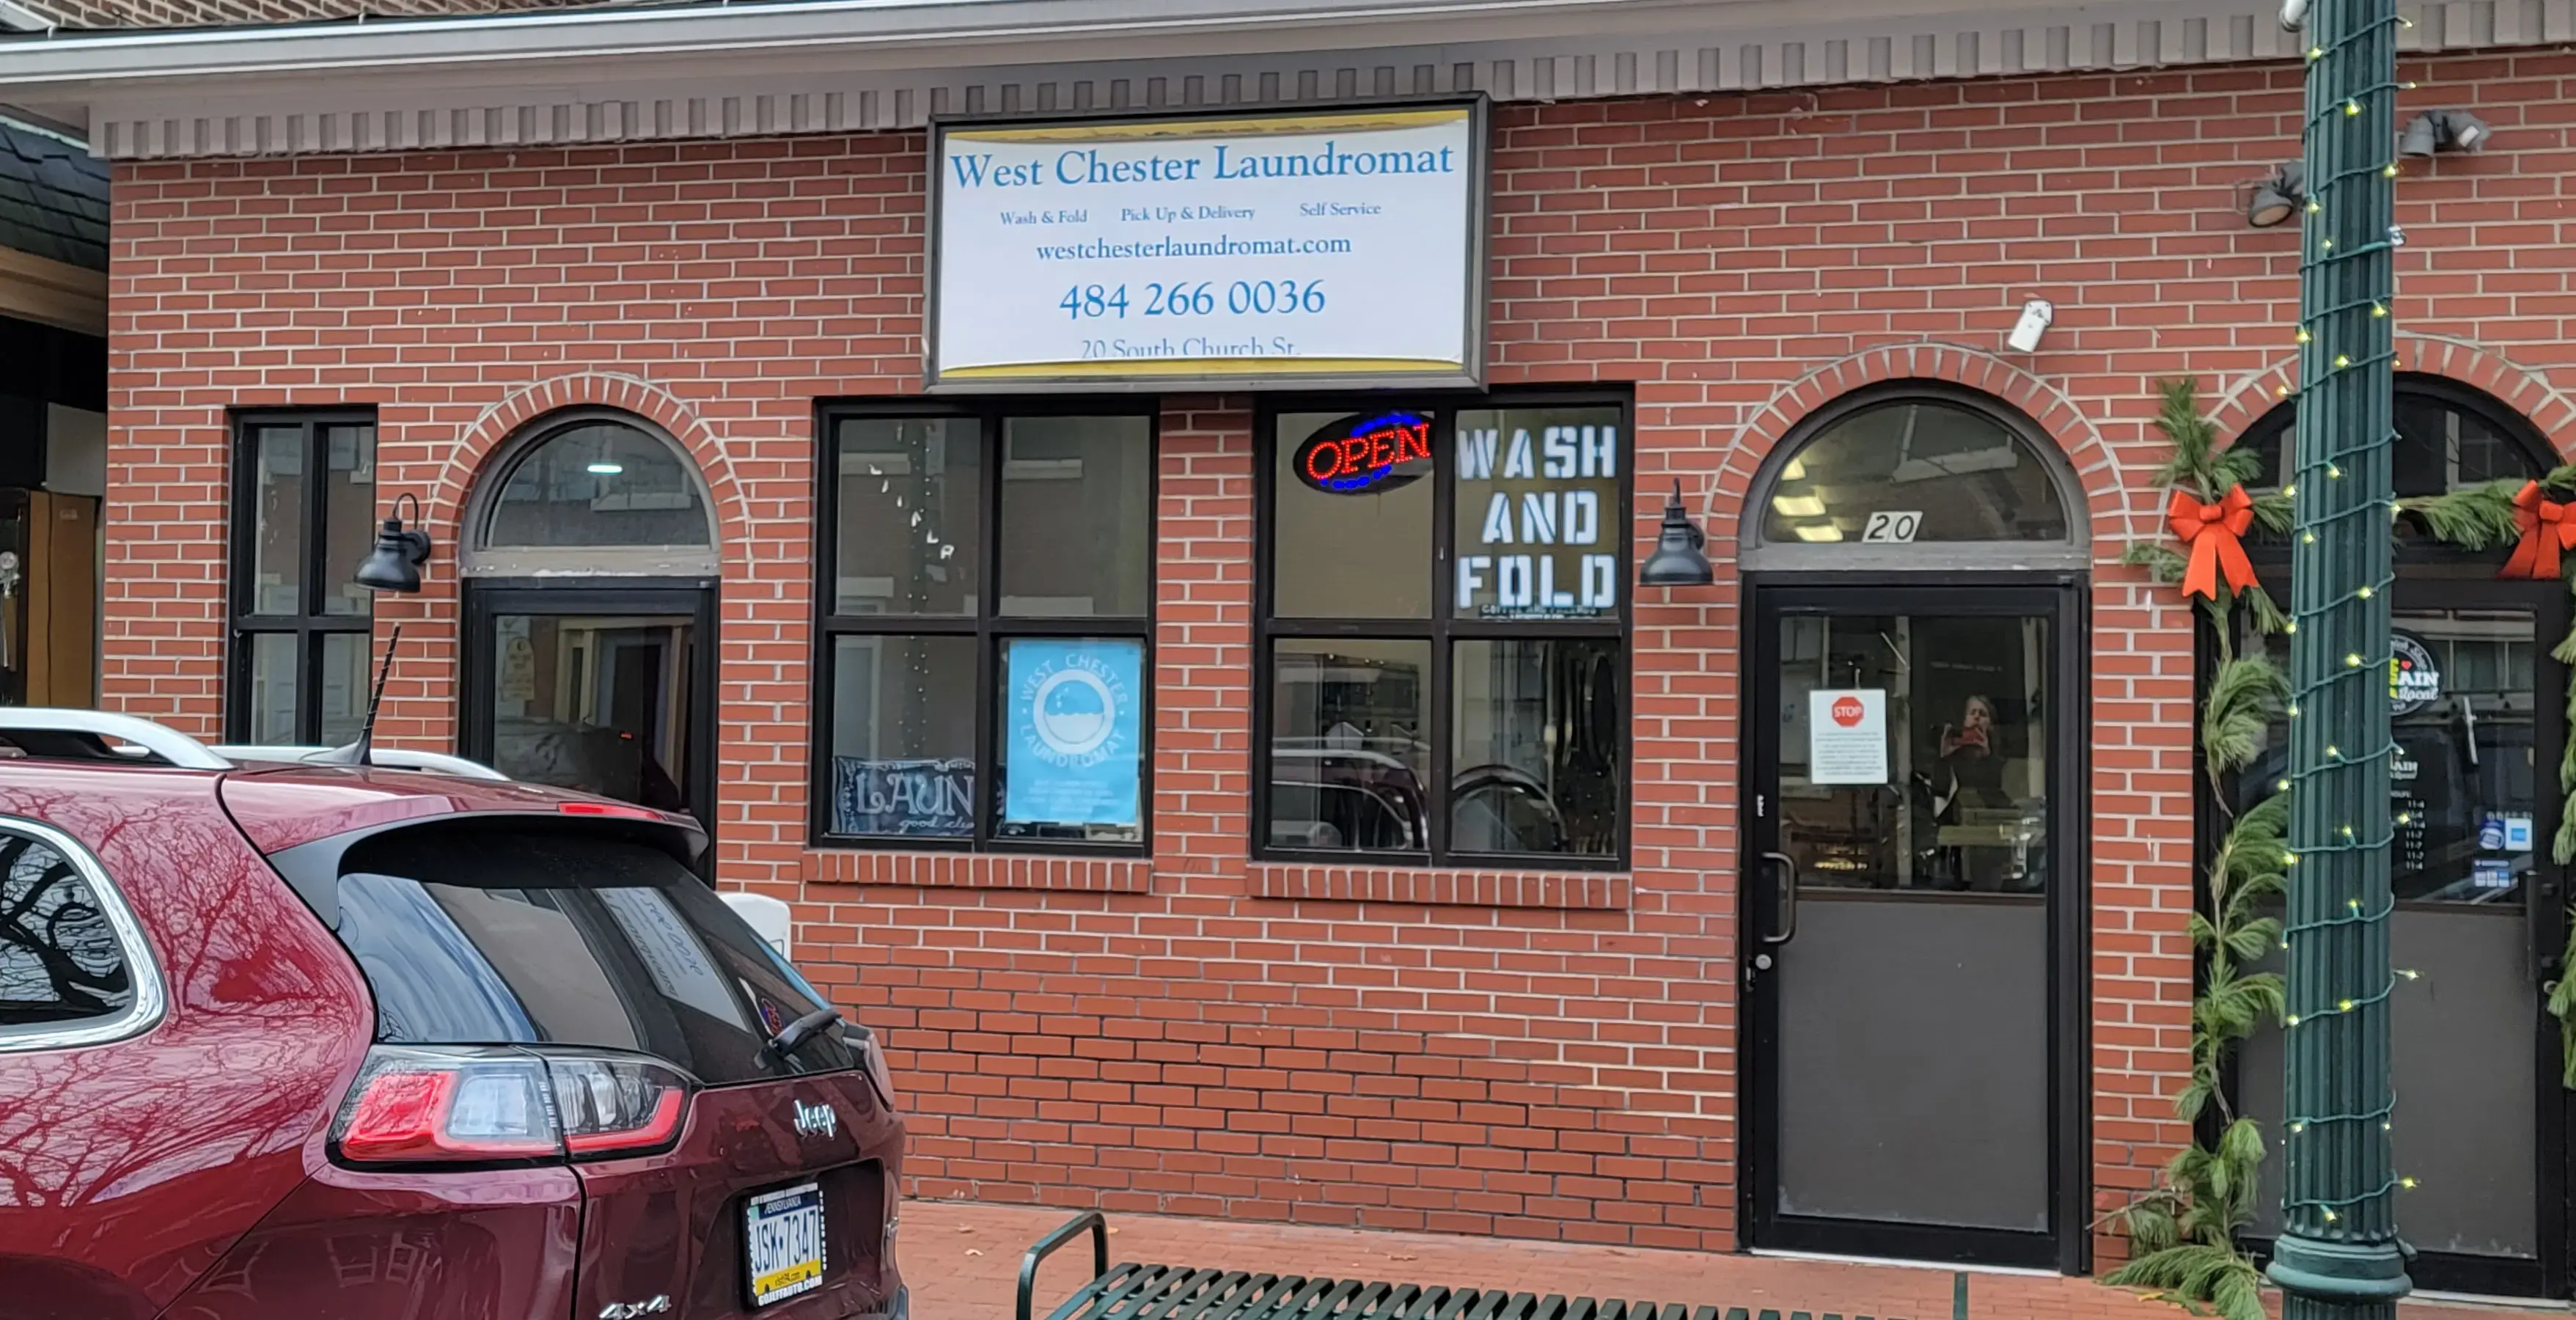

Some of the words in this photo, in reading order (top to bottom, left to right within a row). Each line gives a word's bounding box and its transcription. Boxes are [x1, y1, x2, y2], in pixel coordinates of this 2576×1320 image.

[950, 154, 1042, 188] West
[1054, 150, 1201, 187] Chester
[1213, 140, 1455, 180] Laundromat
[999, 212, 1038, 226] Wash
[1041, 212, 1054, 225] &
[1058, 210, 1088, 224] Fold
[1120, 208, 1153, 222] Pick
[1156, 208, 1178, 222] Up
[1181, 206, 1195, 221] &
[1198, 205, 1255, 222] Delivery
[1299, 202, 1326, 217] Self
[1329, 202, 1382, 217] Service
[1036, 233, 1352, 261] westchesterlaundromat.com
[1058, 284, 1131, 321] 484
[1144, 281, 1215, 317] 266
[1227, 279, 1327, 316] 0036
[1081, 339, 1107, 359] 20
[1112, 338, 1175, 357] South
[1182, 337, 1264, 356] Church
[1306, 422, 1432, 480] OPEN
[1456, 425, 1615, 480] WASH
[1481, 490, 1599, 544] AND
[1868, 514, 1915, 540] 20
[1456, 554, 1615, 609] FOLD
[1020, 659, 1054, 701] WEST
[1065, 653, 1129, 704] CHESTER
[1833, 705, 1863, 718] STOP
[1019, 724, 1126, 769] LAUNDROMAT
[898, 815, 939, 835] good
[793, 1099, 838, 1139] Jeep
[763, 1195, 802, 1215] PENNSYLVANIA
[757, 1275, 823, 1308] GOJEFFAUTO.COM
[598, 1294, 672, 1320] 4x4
